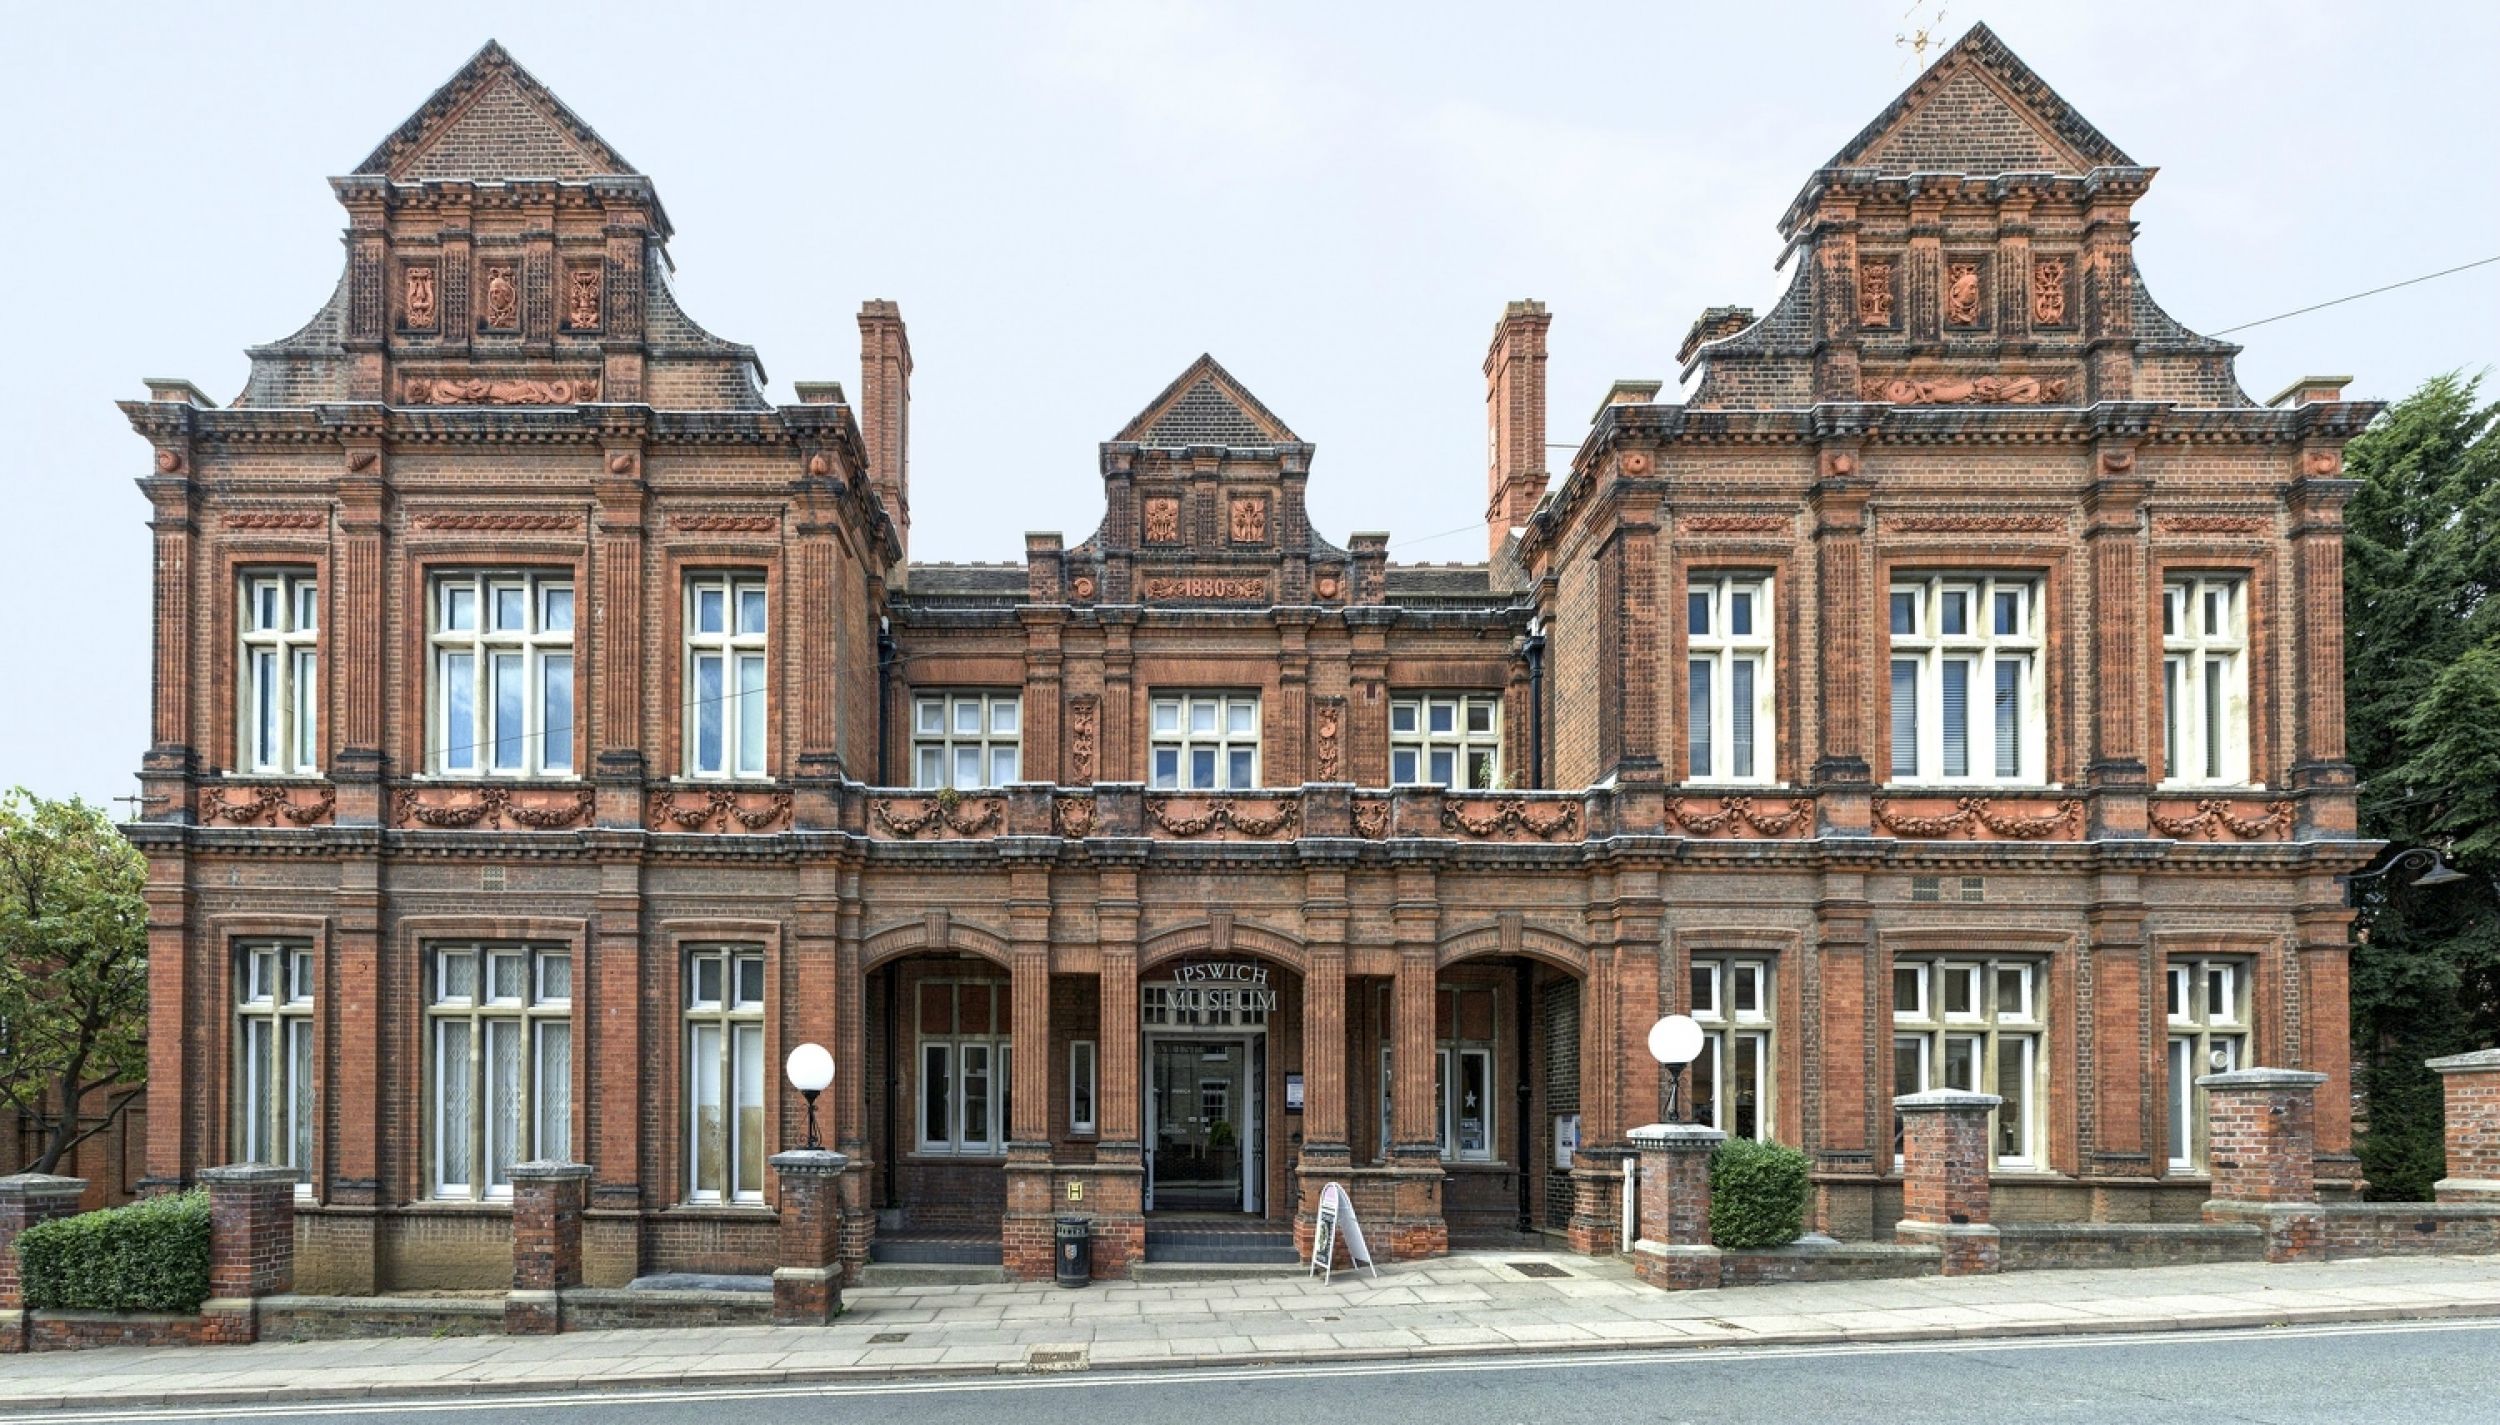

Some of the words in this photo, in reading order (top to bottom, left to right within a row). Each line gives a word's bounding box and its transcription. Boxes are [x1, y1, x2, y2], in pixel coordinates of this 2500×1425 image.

[1186, 579, 1225, 597] 1880
[1173, 963, 1269, 984] IPSWICH
[1166, 990, 1277, 1011] MUSEUM
[1070, 1184, 1081, 1199] H
